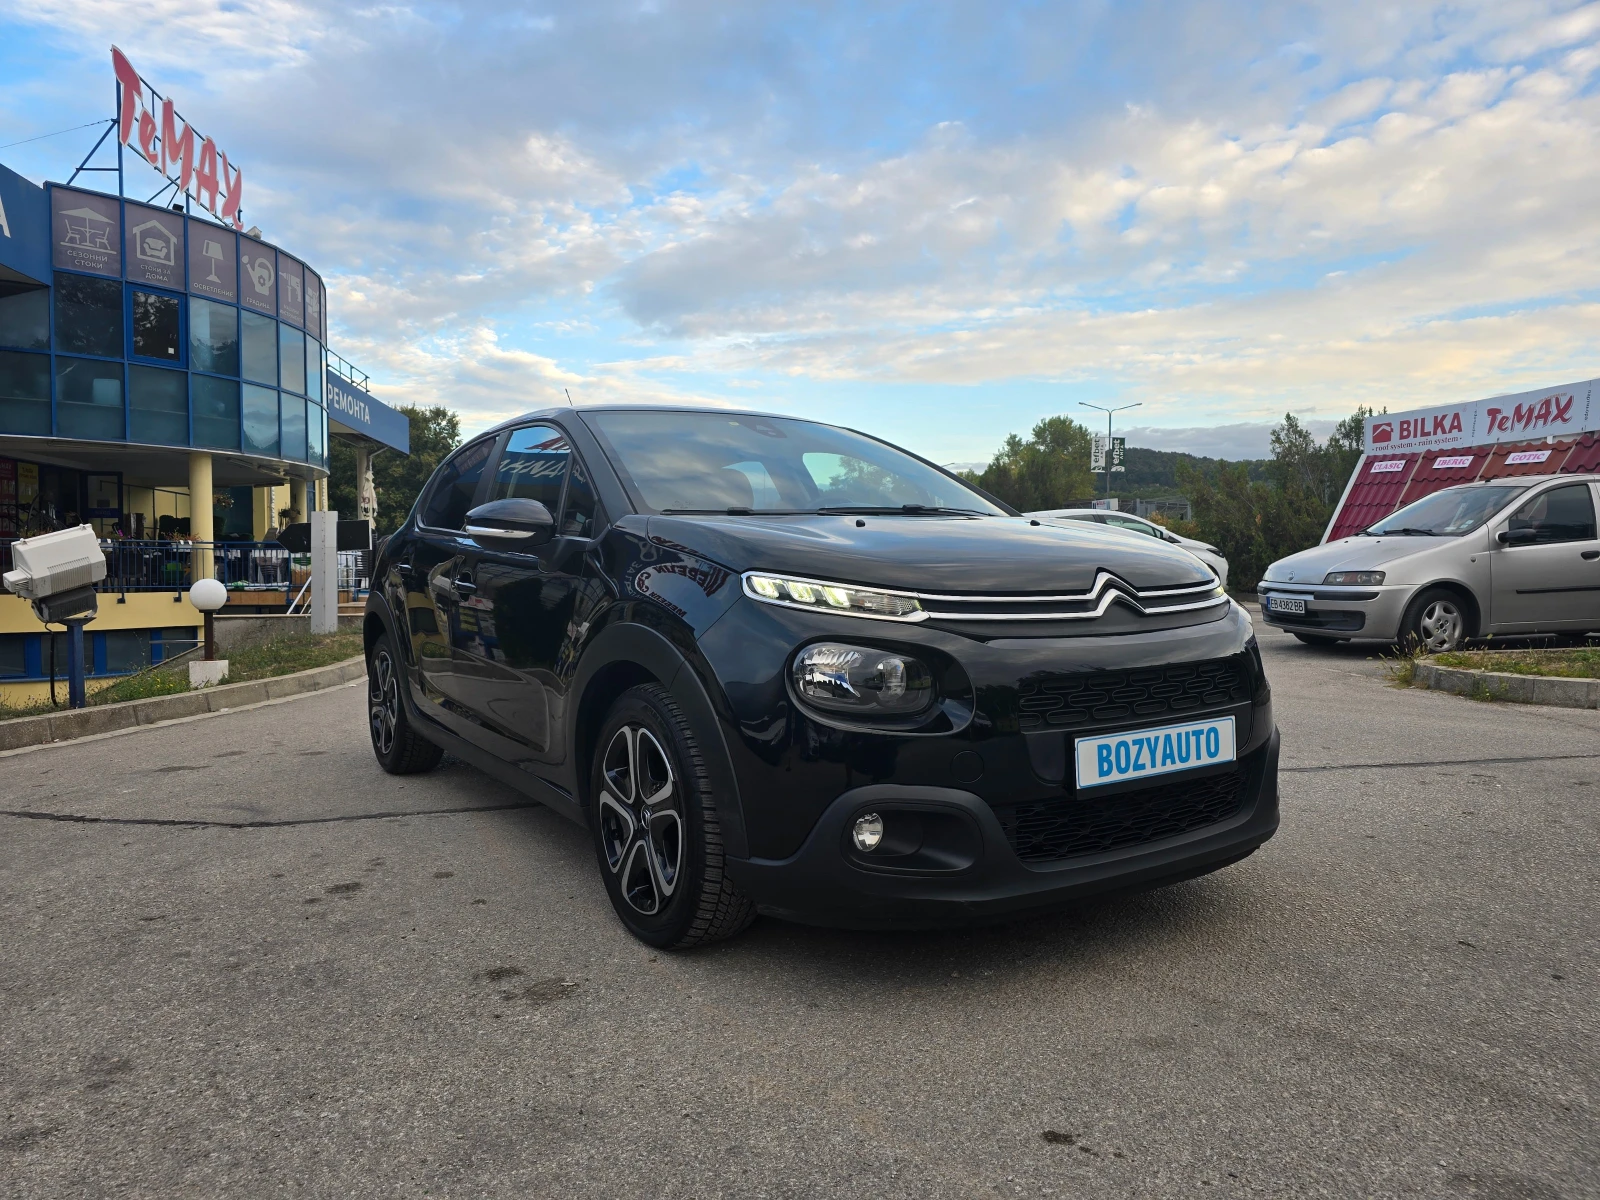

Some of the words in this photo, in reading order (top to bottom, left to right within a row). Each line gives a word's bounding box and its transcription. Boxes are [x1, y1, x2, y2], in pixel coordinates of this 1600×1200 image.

[67, 249, 108, 263] СЕЗОННИ
[74, 259, 103, 270] СТОКИ
[140, 264, 162, 274] СТОКИ
[145, 272, 169, 282] ДОМА
[193, 282, 234, 298] ОСВЕТЛЕНИЕ
[246, 296, 270, 310] ГРАДИНА
[328, 384, 370, 425] РЕМОНТА
[1487, 393, 1574, 436] TeMAX
[1399, 412, 1463, 440] BILKA
[1375, 444, 1390, 452] roof
[1390, 441, 1413, 452] system
[1418, 439, 1433, 447] rain
[1434, 436, 1459, 446] system
[1437, 457, 1469, 467] IBERIC
[1511, 452, 1546, 462] GOTIC
[1373, 462, 1403, 472] CLASIC
[1096, 726, 1220, 778] BOZYAUTO
